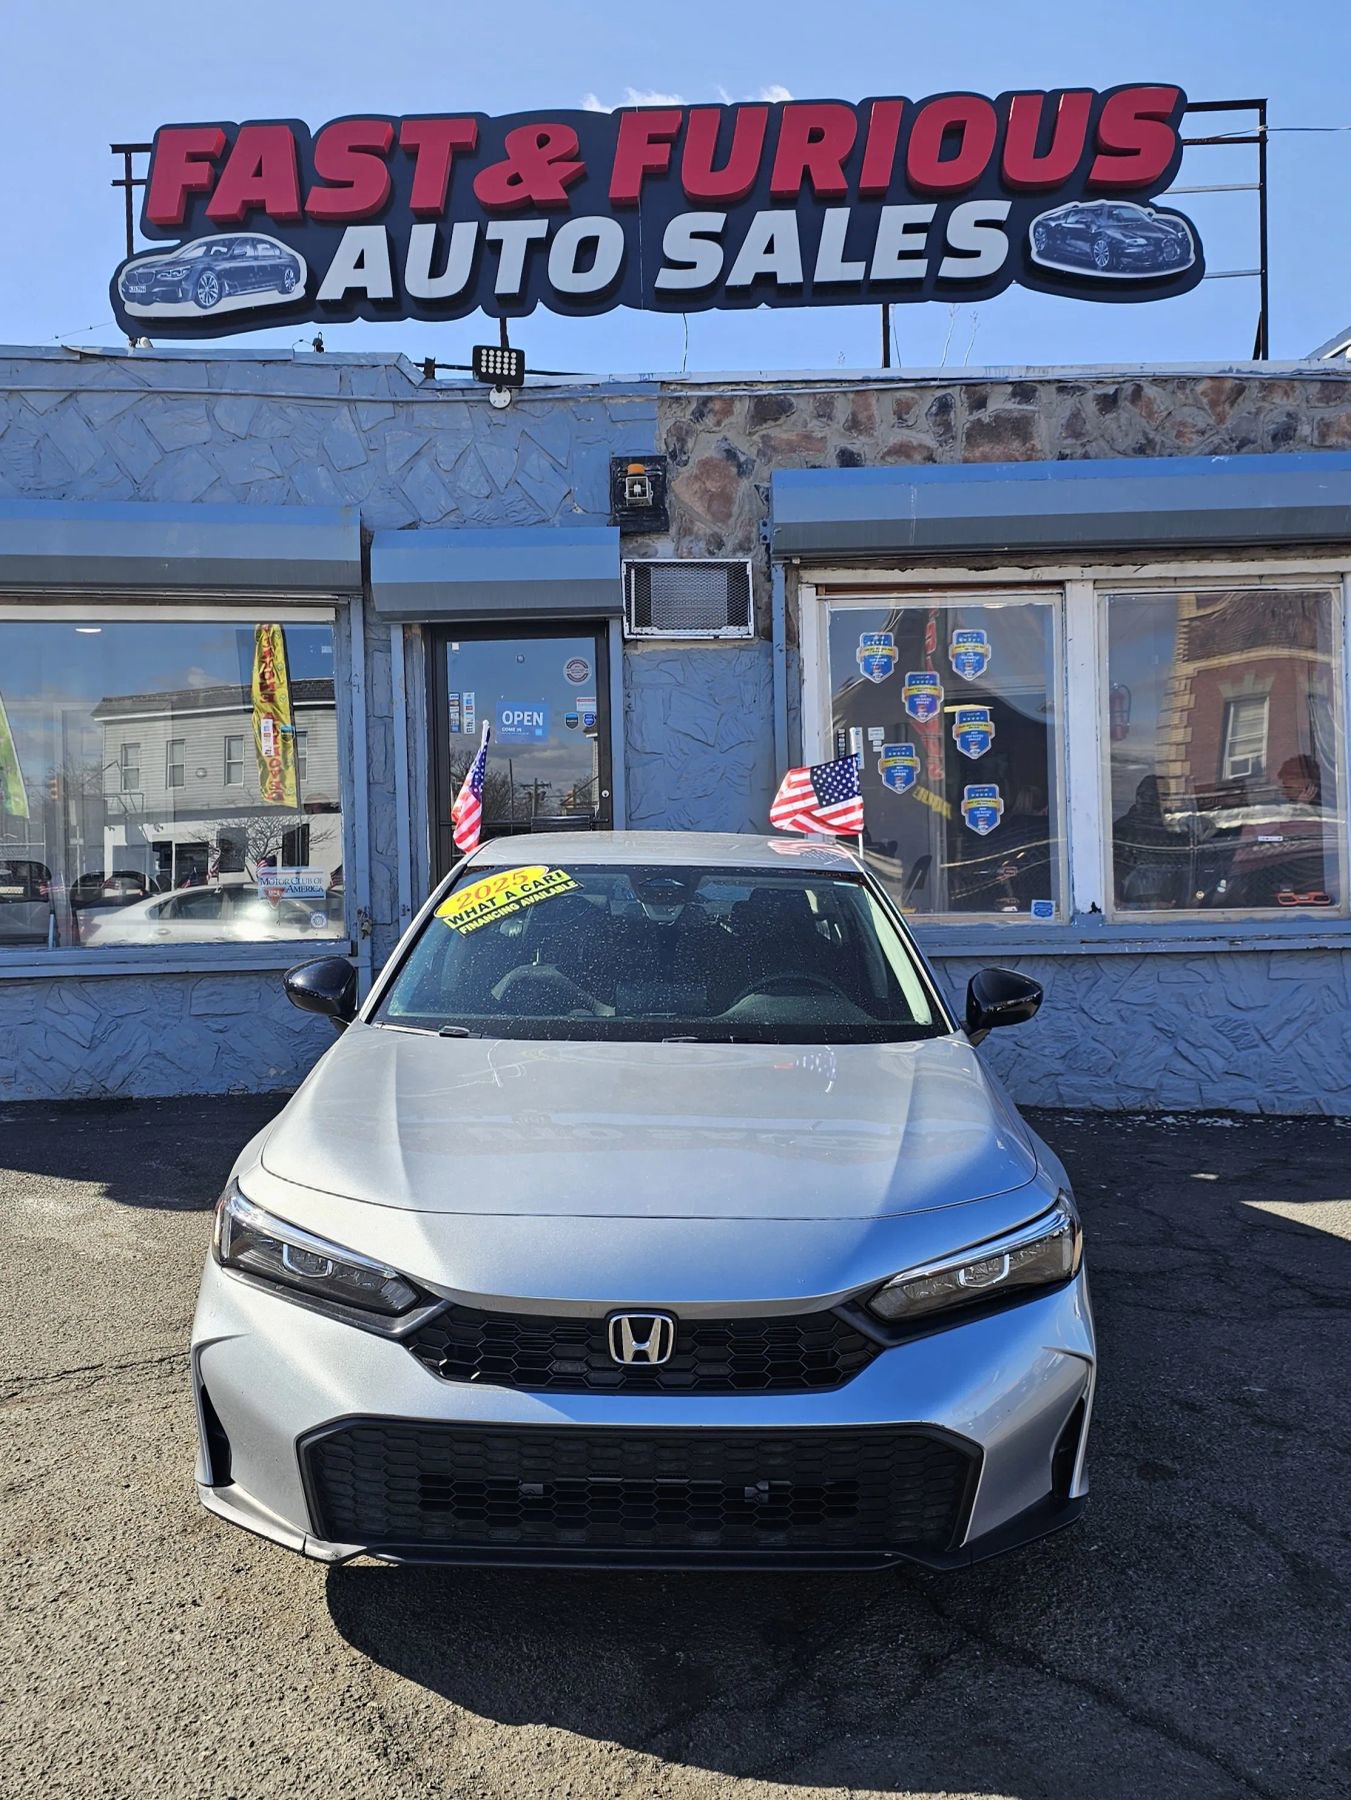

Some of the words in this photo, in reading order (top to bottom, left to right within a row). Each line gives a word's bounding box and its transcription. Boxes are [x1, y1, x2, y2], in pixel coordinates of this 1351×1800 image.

[146, 117, 478, 225] FAST
[473, 122, 586, 212] &
[608, 85, 1182, 206] FURIOUS
[315, 215, 624, 301] AUTO
[653, 200, 1012, 291] SALES
[502, 710, 544, 726] OPEN
[260, 877, 290, 886] MOTOR
[290, 876, 313, 885] CLUB
[286, 885, 324, 893] AMERICA
[448, 897, 497, 926] WHAT
[505, 890, 518, 901] A
[520, 871, 564, 893] CAR!
[456, 870, 529, 911] 2025
[460, 903, 520, 934] FINANCING
[520, 880, 578, 907] AVAILABLE
